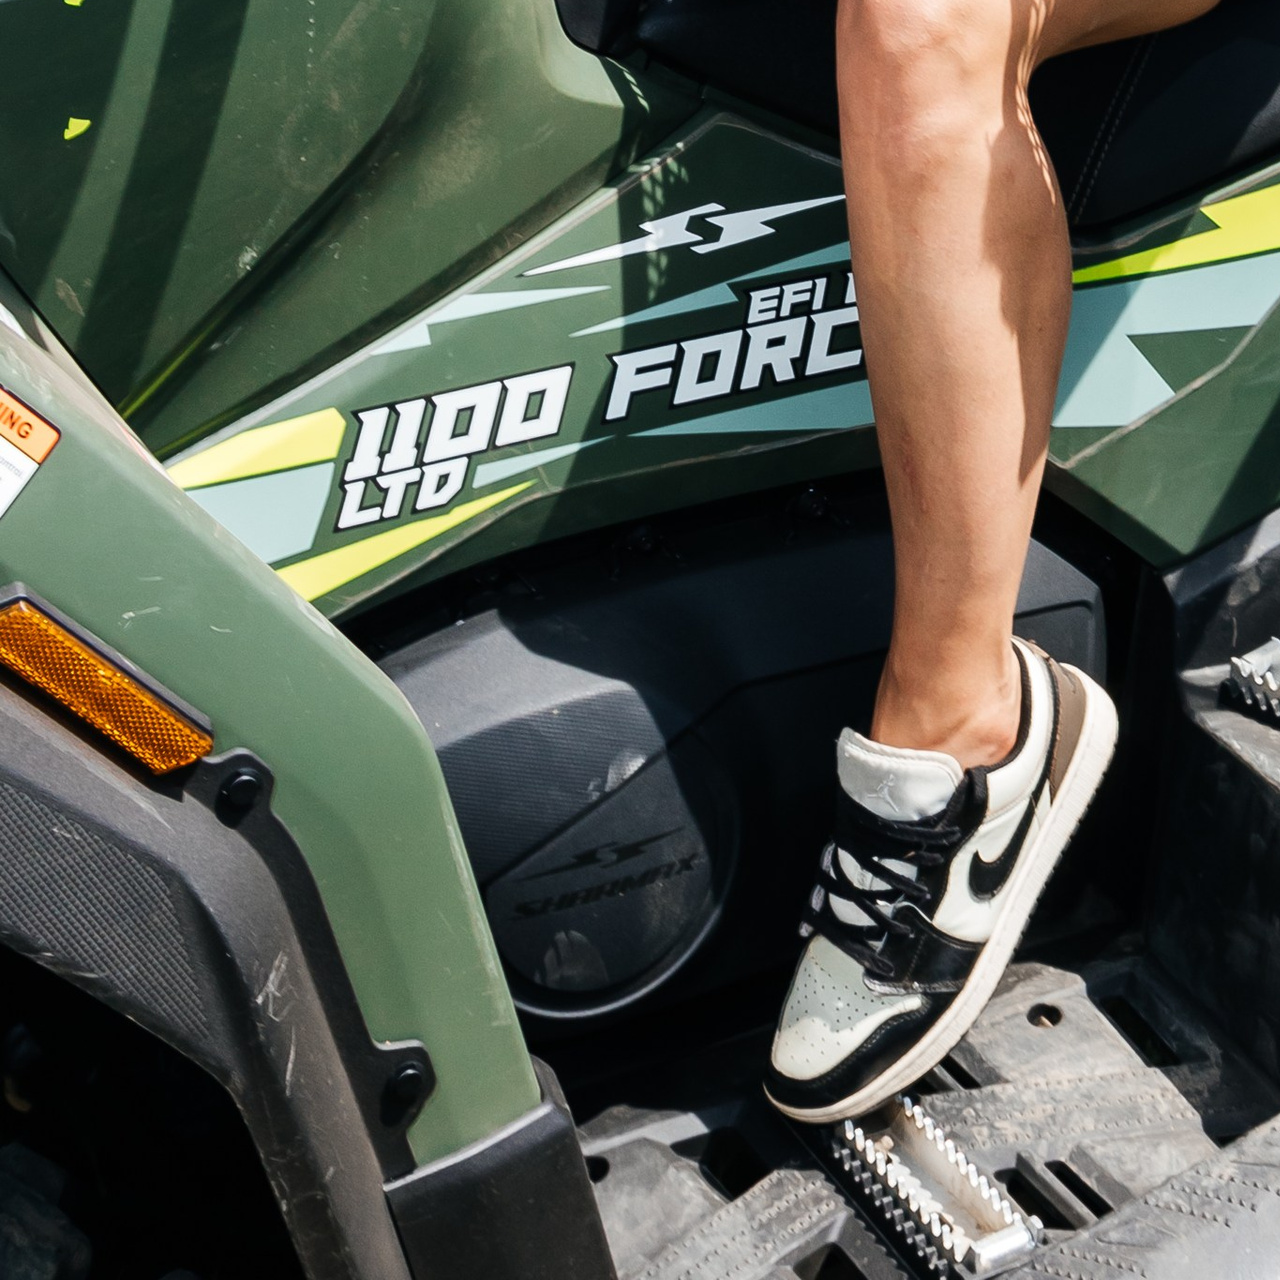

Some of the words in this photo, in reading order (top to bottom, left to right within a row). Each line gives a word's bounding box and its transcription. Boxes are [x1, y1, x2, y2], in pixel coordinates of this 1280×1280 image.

[747, 277, 827, 324] EFI
[344, 365, 573, 480] 1100
[337, 457, 468, 530] LTD
